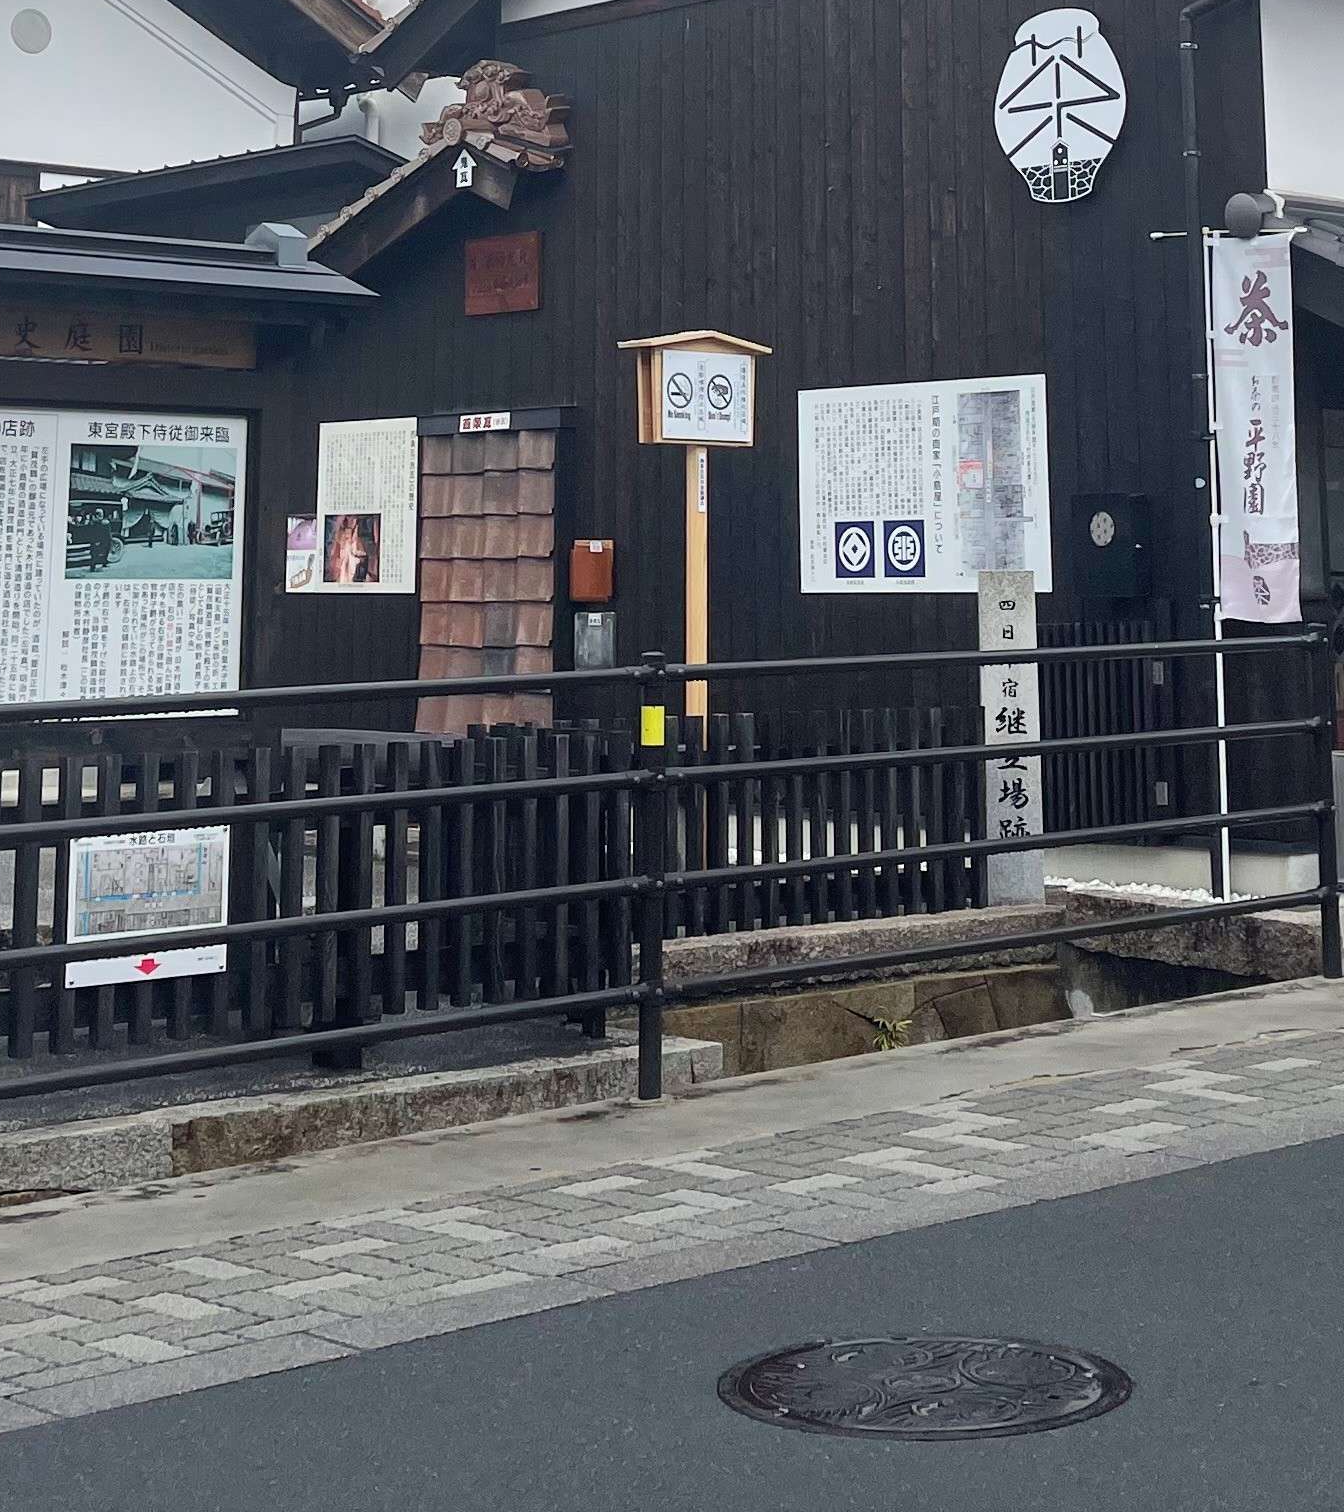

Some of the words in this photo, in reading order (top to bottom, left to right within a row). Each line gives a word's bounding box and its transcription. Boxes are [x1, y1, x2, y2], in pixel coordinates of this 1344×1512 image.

[1224, 270, 1289, 347] 茶
[995, 598, 1032, 841] 四日宿継立場跡
